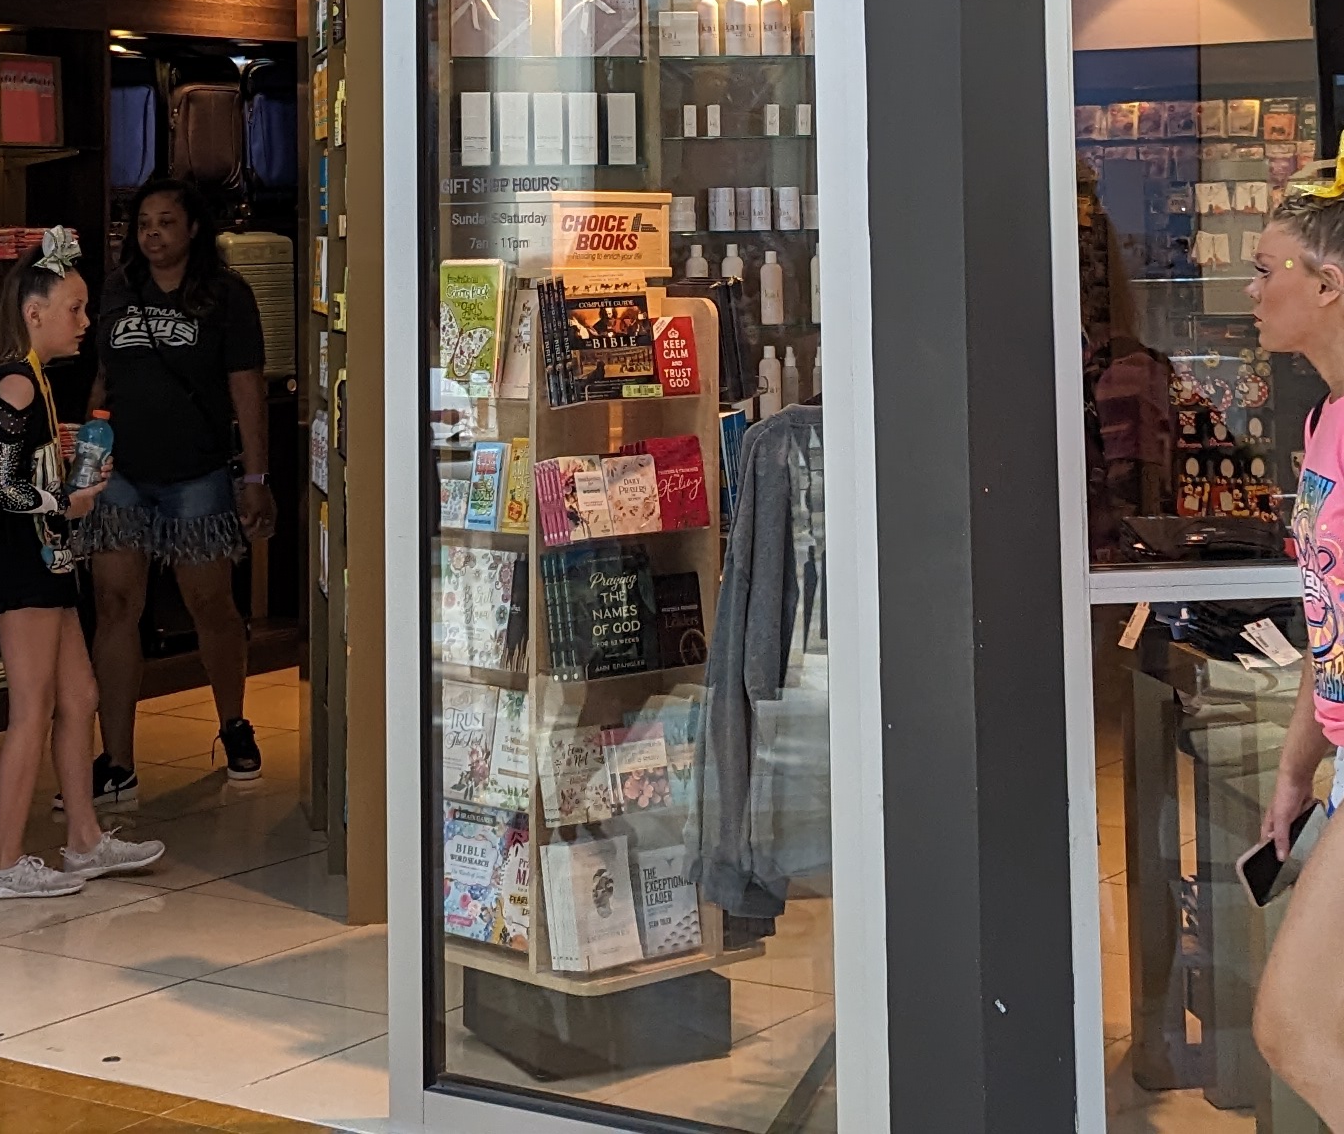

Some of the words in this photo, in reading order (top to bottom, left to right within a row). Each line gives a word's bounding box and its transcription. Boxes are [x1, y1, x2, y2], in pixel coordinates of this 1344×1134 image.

[440, 178, 470, 195] GIFT
[472, 177, 509, 194] SHOP
[513, 177, 560, 193] HOURS
[452, 213, 491, 226] Sunda
[499, 212, 547, 227] Saturday
[561, 215, 628, 232] CHOICE
[501, 237, 529, 251] 11pm
[576, 233, 638, 250] BOOKS
[127, 306, 186, 319] PLTINUM
[593, 336, 637, 348] BIBLE
[663, 339, 686, 349] KEEP
[663, 349, 689, 358] CALM
[664, 368, 692, 378] TRUST
[669, 378, 690, 387] GOD
[590, 572, 637, 590] Praying
[600, 590, 627, 603] THE
[592, 604, 638, 621] NAMES
[592, 624, 609, 637] OF
[613, 620, 641, 633] GOD
[456, 844, 486, 858] BIBLE
[643, 867, 657, 880] THE
[646, 891, 673, 906] LEADER
